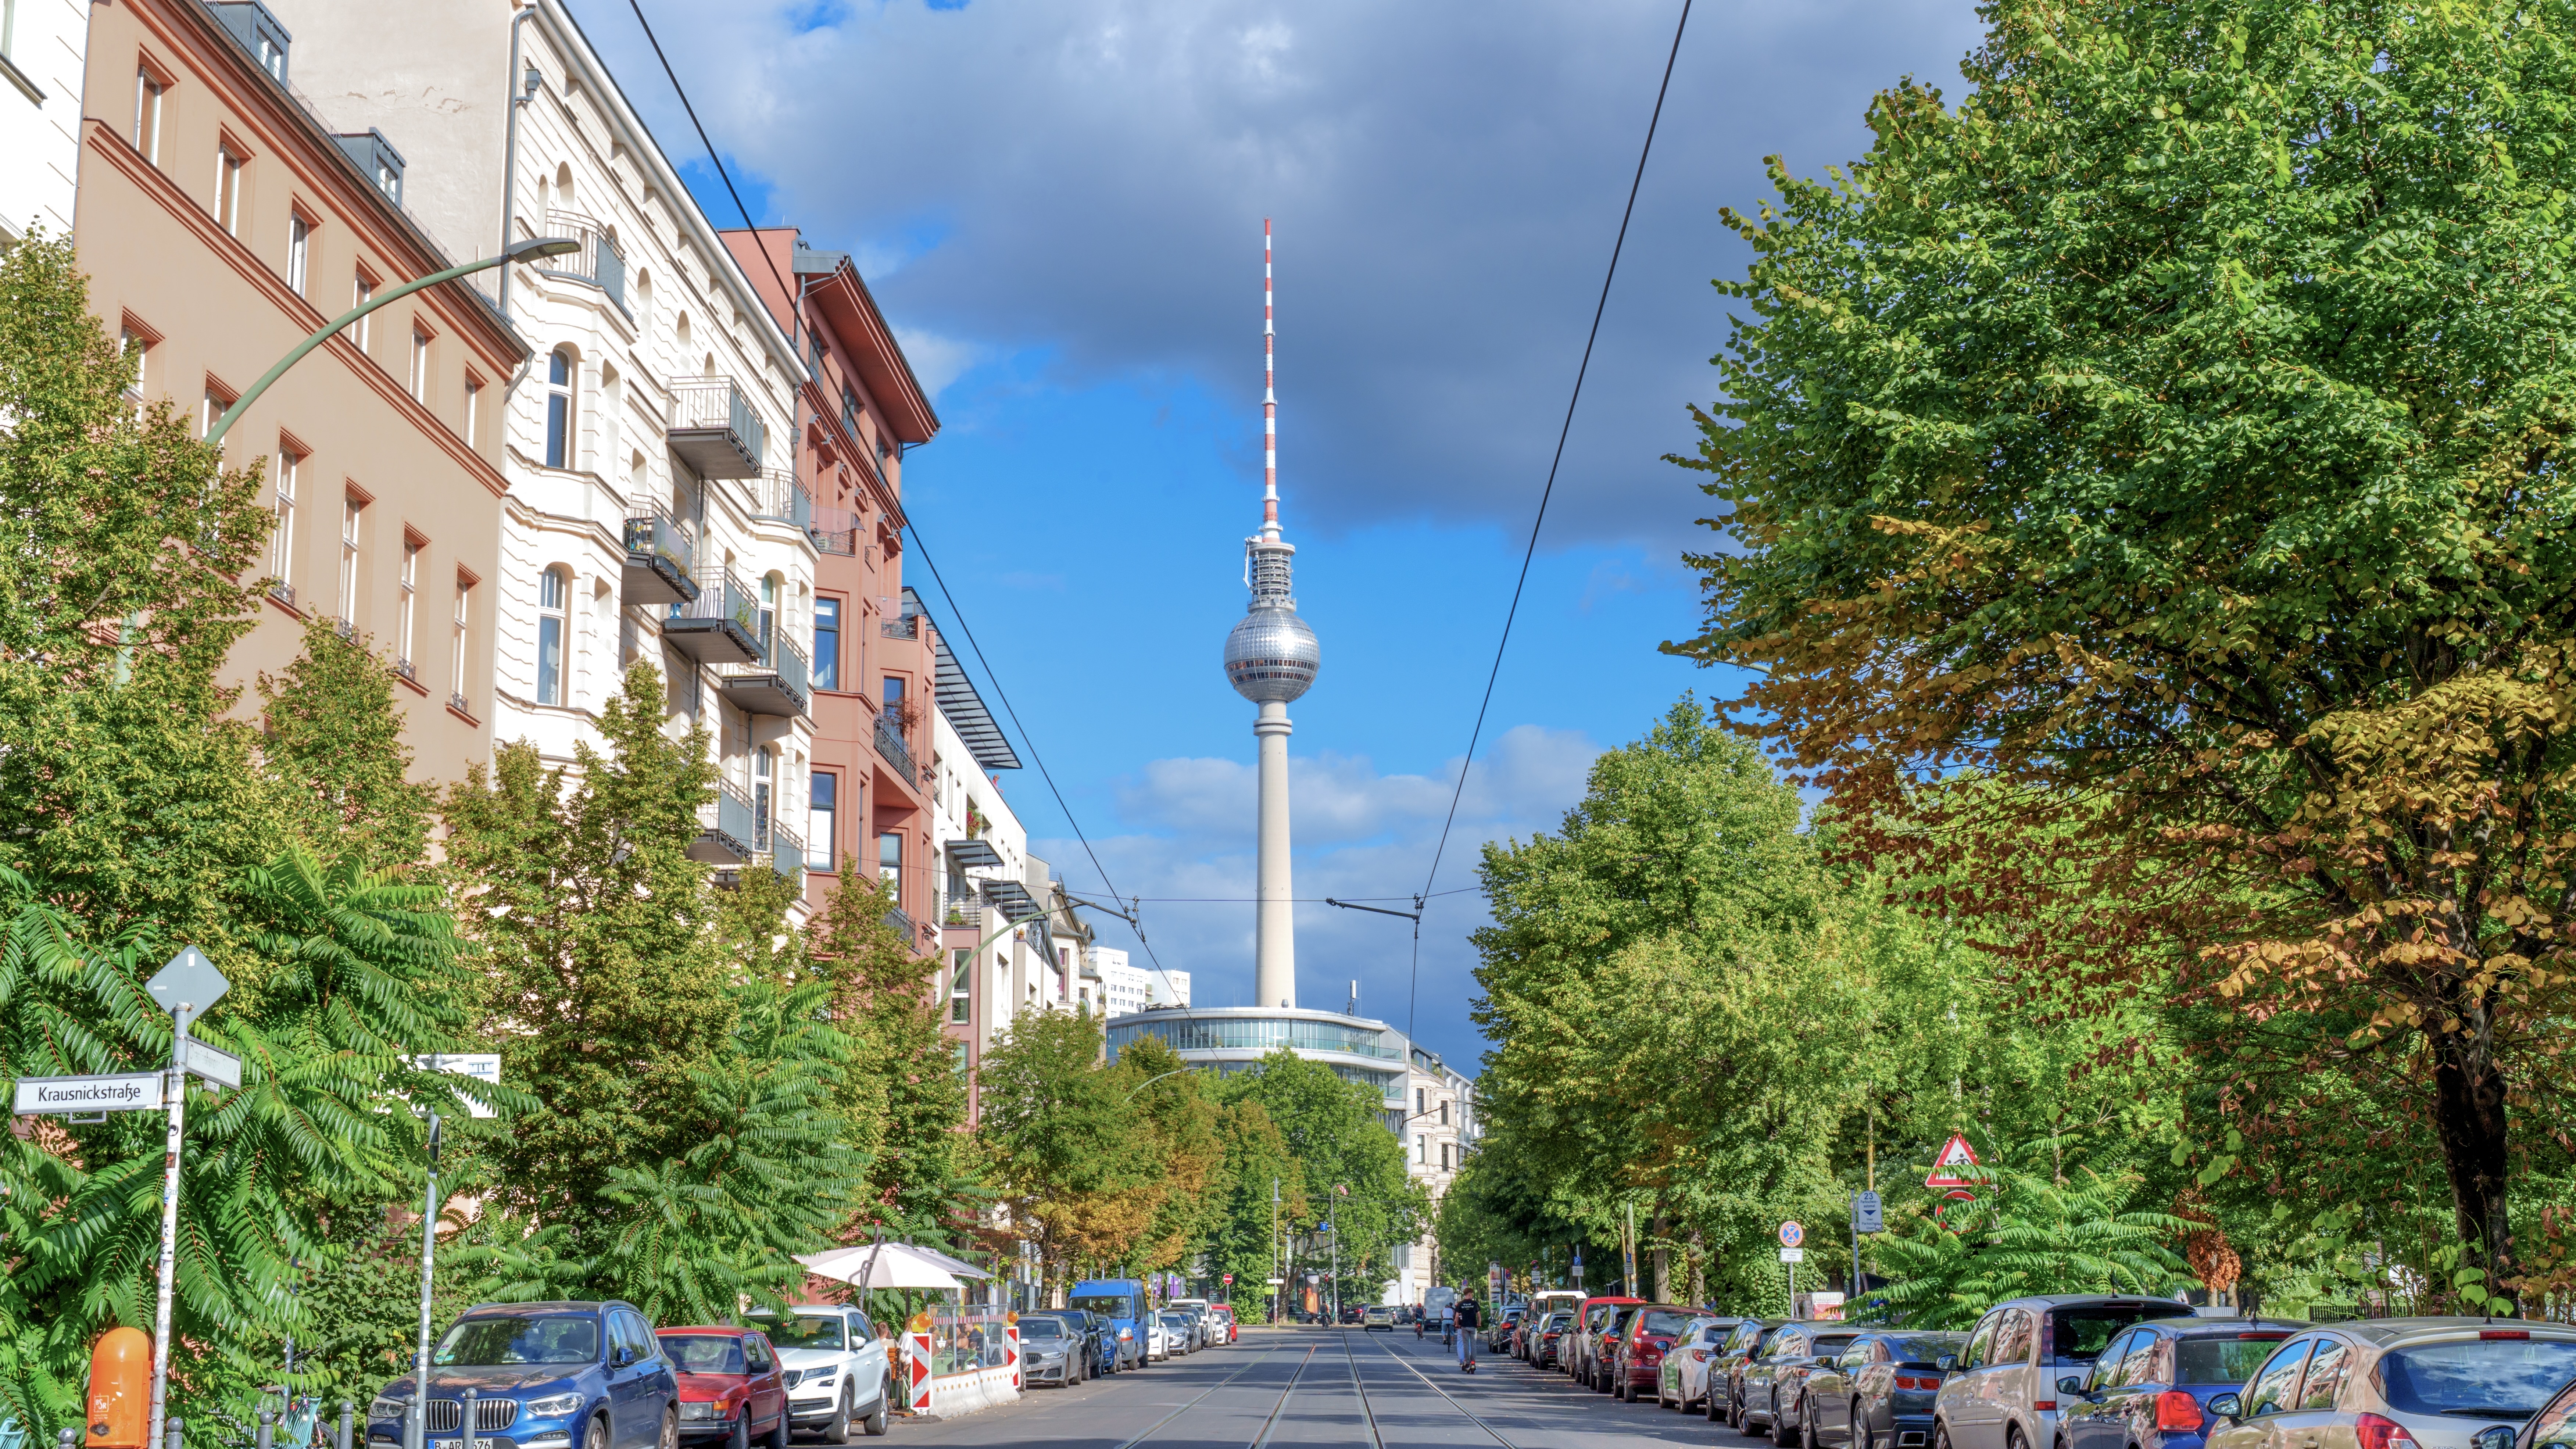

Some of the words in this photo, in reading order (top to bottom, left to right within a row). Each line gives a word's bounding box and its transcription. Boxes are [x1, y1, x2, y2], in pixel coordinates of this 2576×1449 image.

[468, 1063, 494, 1073] MLM
[38, 1083, 140, 1102] Krausnickstraße
[96, 1399, 107, 1410] BSR
